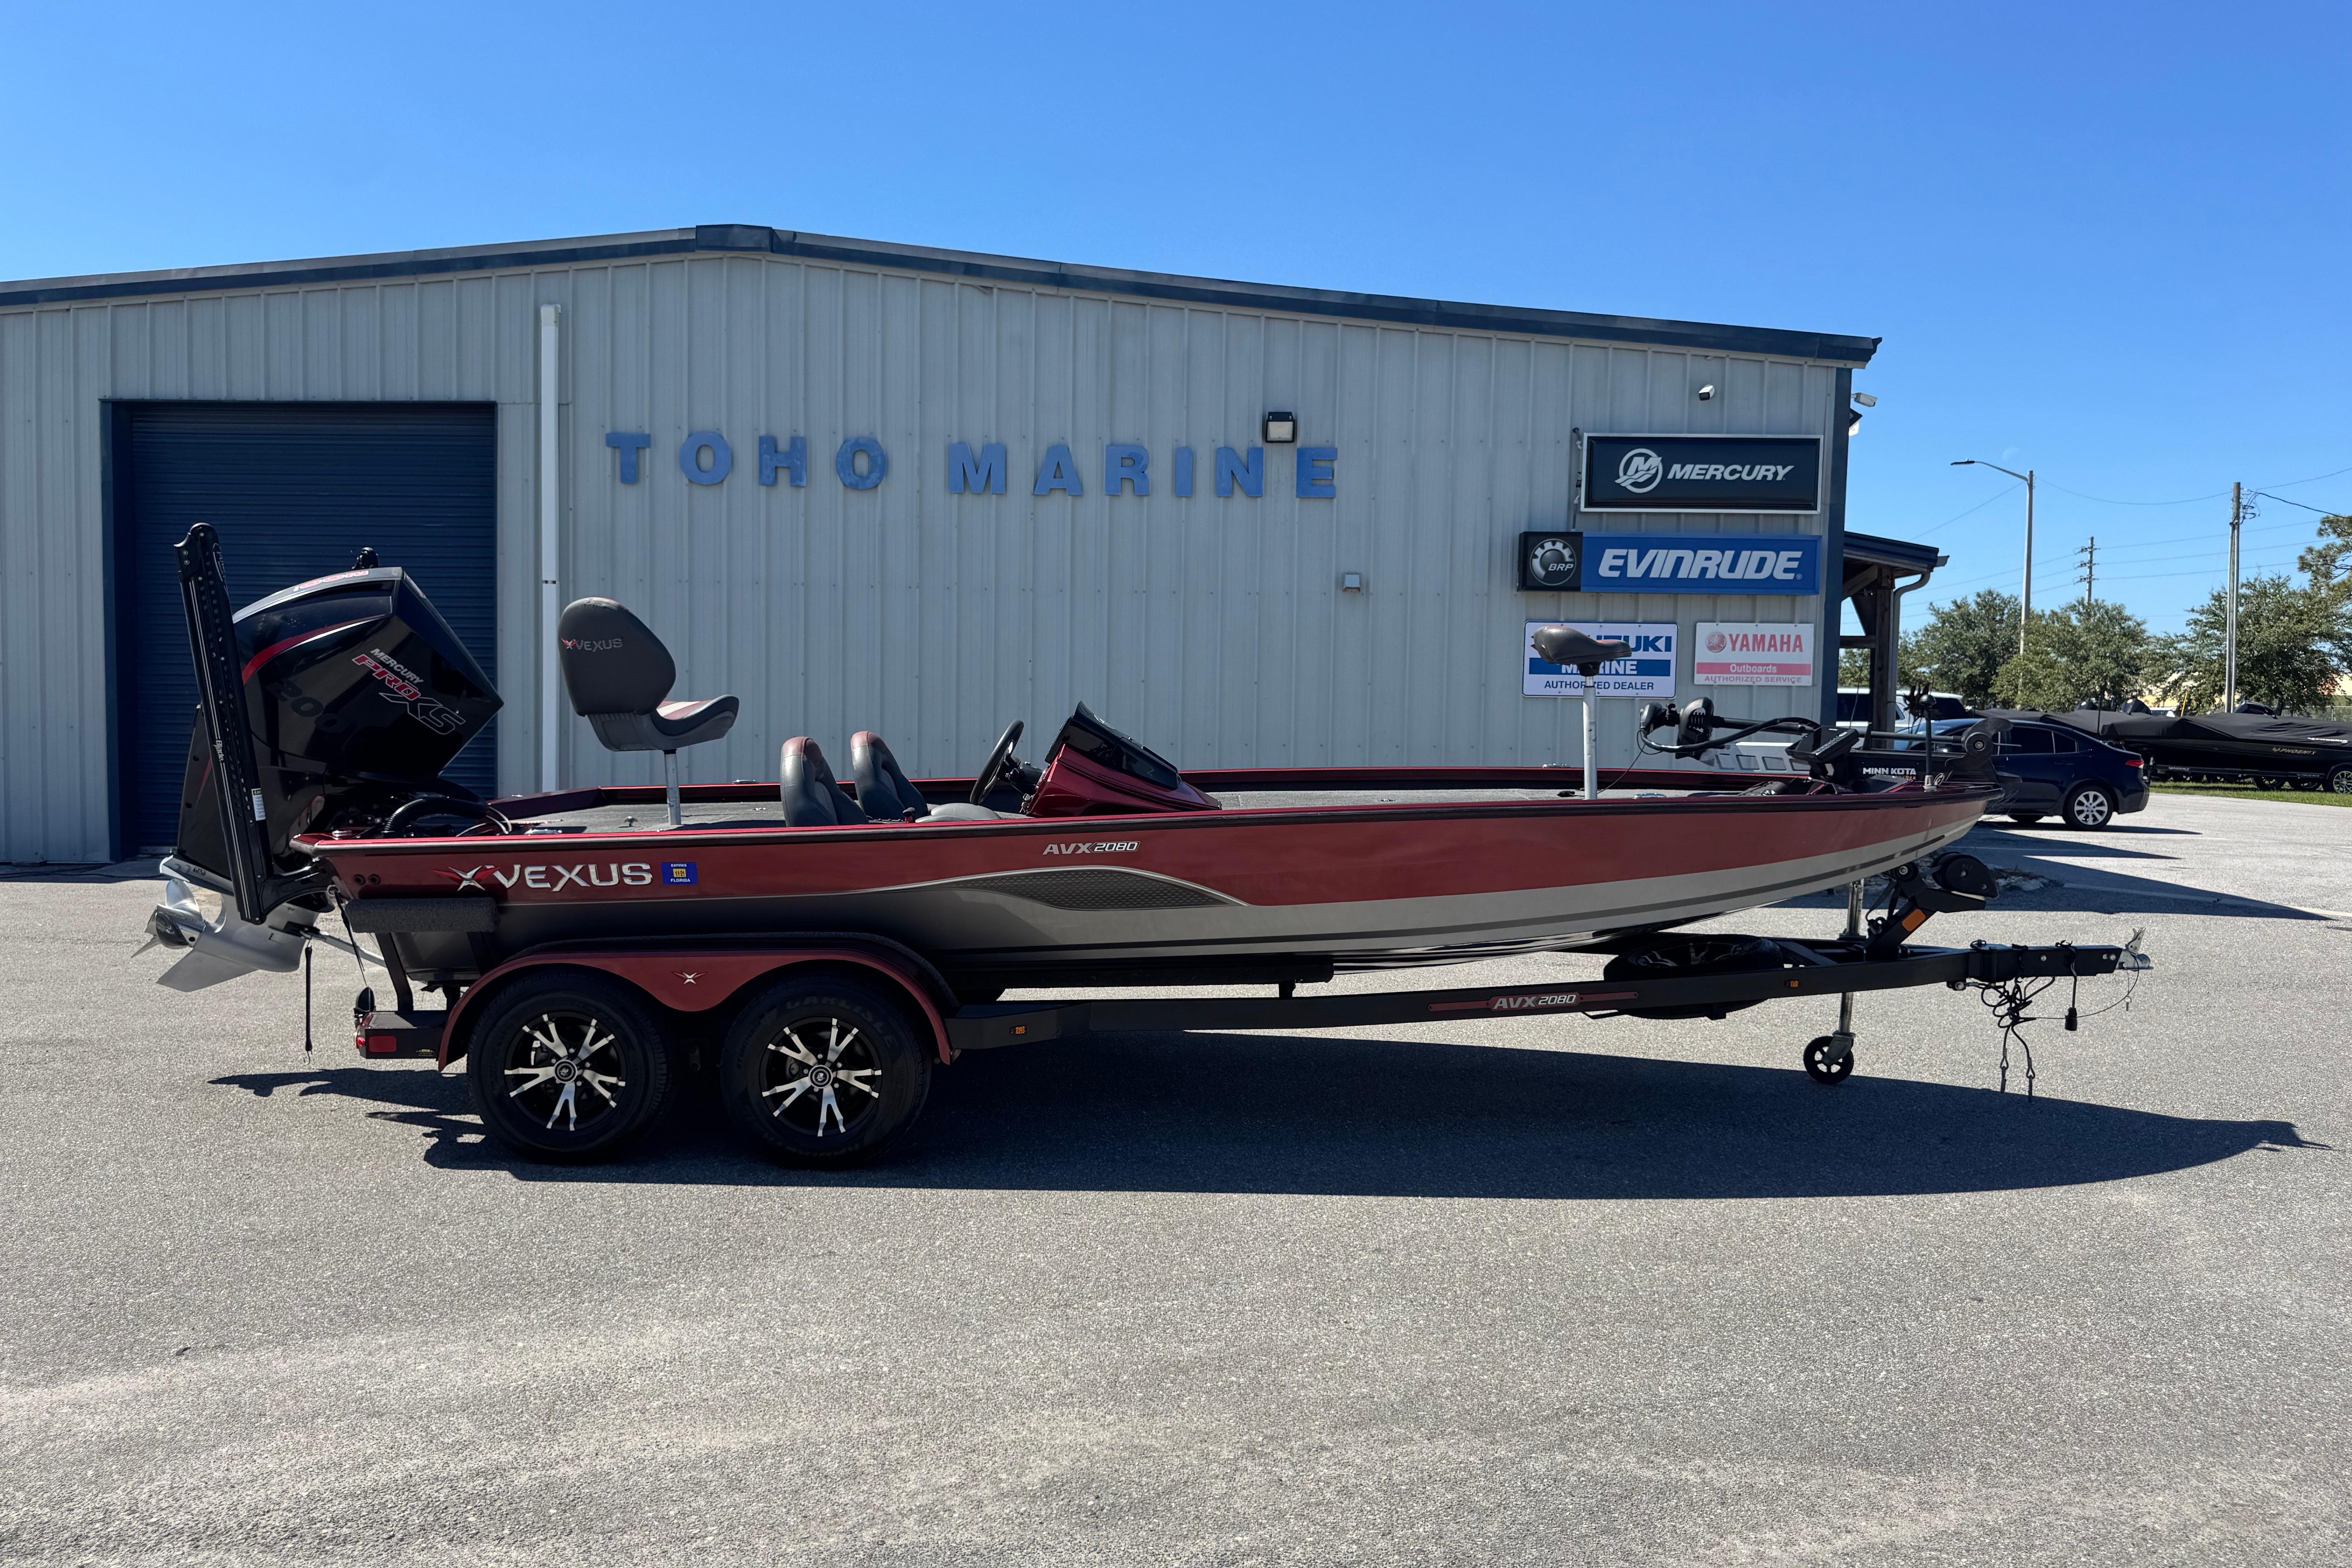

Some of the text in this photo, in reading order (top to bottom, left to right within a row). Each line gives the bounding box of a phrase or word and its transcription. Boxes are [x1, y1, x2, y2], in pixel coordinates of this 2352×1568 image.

[605, 431, 1338, 498] TOHO MARINE
[1666, 464, 1794, 481] MERCURY
[1548, 563, 1574, 571] BRP
[1598, 548, 1803, 580] EVINRUDE
[576, 638, 623, 652] VEXUS
[1729, 633, 1804, 653] YAMAHA
[371, 648, 424, 684] MERCURY
[1730, 663, 1777, 673] Outboards
[1613, 681, 1654, 690] DEALER
[352, 654, 467, 735] PRO XS
[1094, 842, 1138, 852] 2080
[485, 861, 653, 892] VEXUS
[1538, 994, 1577, 1005] 2080
